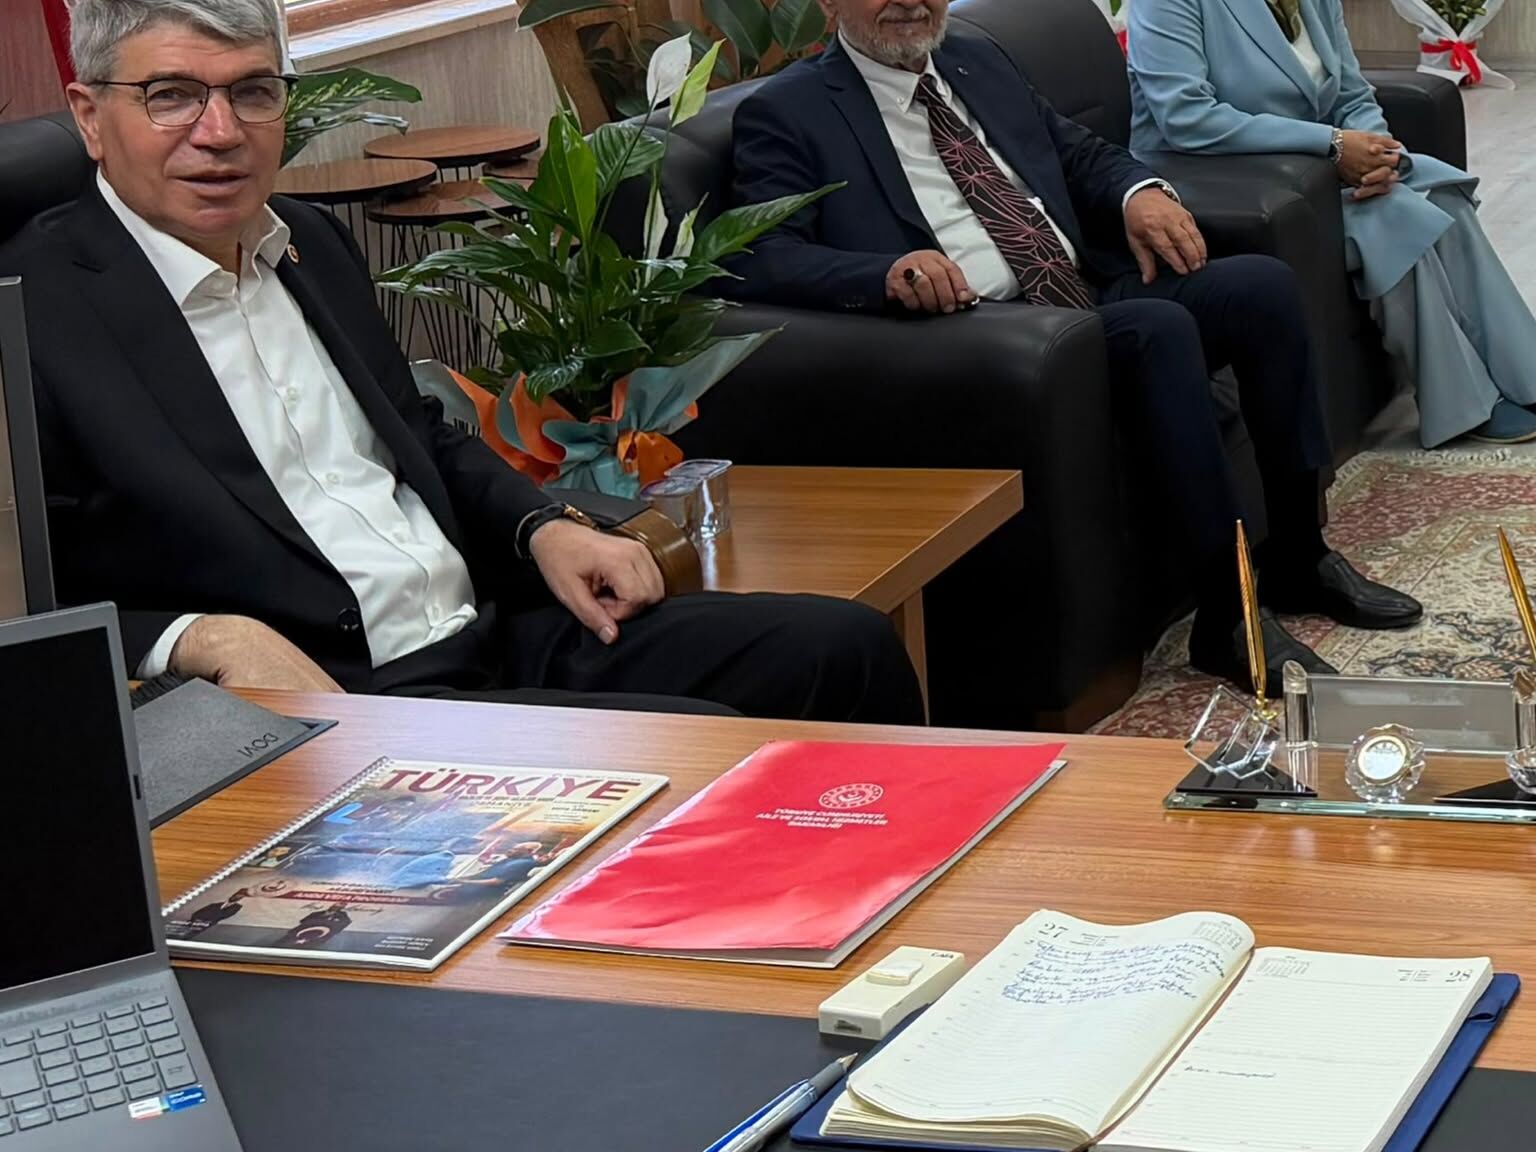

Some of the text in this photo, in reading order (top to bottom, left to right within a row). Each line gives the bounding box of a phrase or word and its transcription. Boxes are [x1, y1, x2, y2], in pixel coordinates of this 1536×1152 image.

[380, 768, 641, 800] TÜRKİYE
[1038, 922, 1068, 939] 27
[1445, 969, 1474, 983] 28
